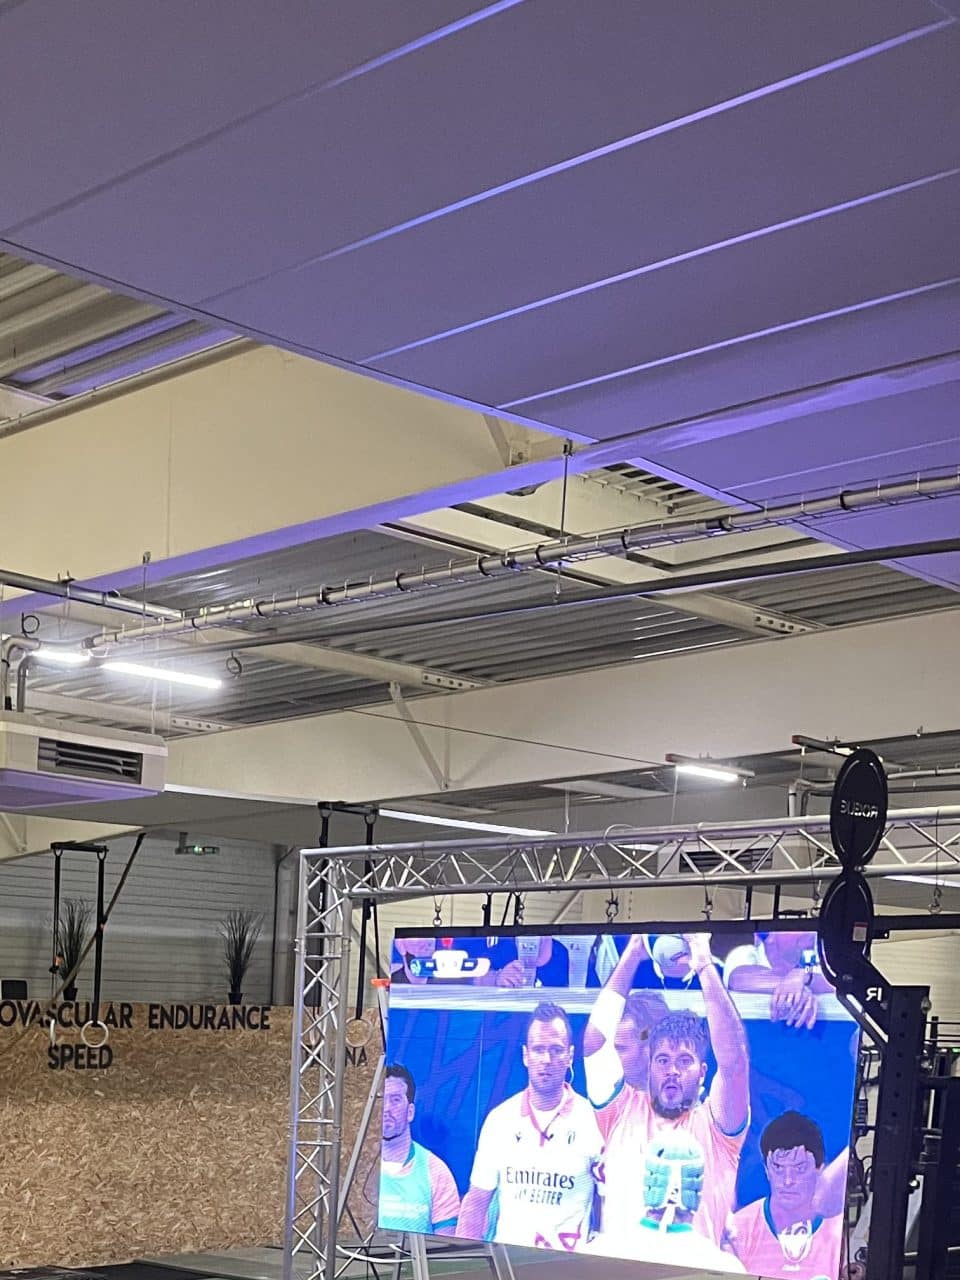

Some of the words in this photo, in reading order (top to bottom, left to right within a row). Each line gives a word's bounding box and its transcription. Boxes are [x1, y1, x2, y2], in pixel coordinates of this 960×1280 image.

[148, 1003, 271, 1030] ENDURANCE
[47, 1043, 113, 1070] SPEED
[506, 1165, 576, 1190] Emirates
